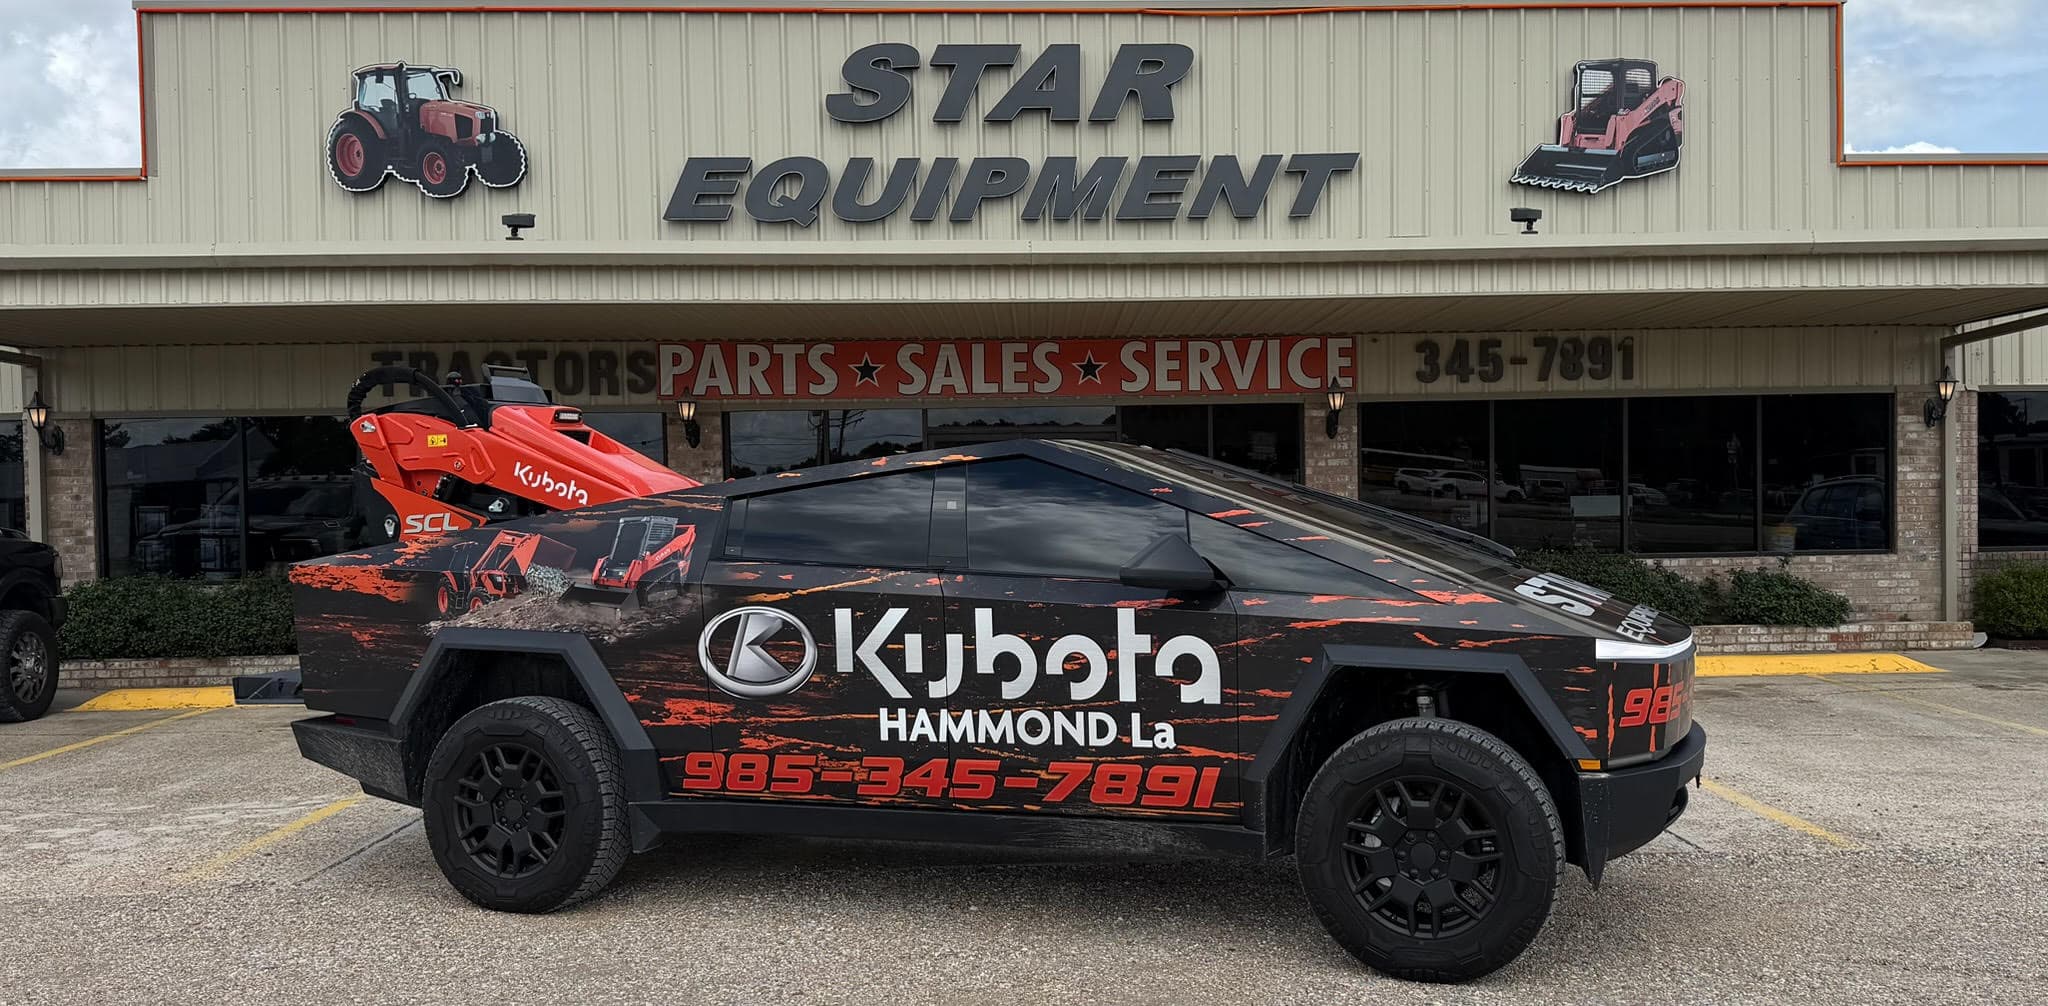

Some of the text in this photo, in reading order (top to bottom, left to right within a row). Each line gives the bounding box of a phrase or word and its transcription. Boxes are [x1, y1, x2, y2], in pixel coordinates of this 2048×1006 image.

[825, 42, 1195, 124] STAR
[663, 152, 1360, 228] EQUIPMENT
[659, 337, 1355, 397] PARTS SALES SERVICE
[1414, 335, 1636, 384] 345-7891
[513, 461, 589, 505] Kubota
[403, 513, 459, 534] SCL
[834, 607, 1222, 704] Kubota
[879, 707, 1178, 750] HAMMOND La
[682, 751, 1222, 809] 985-345-7891
